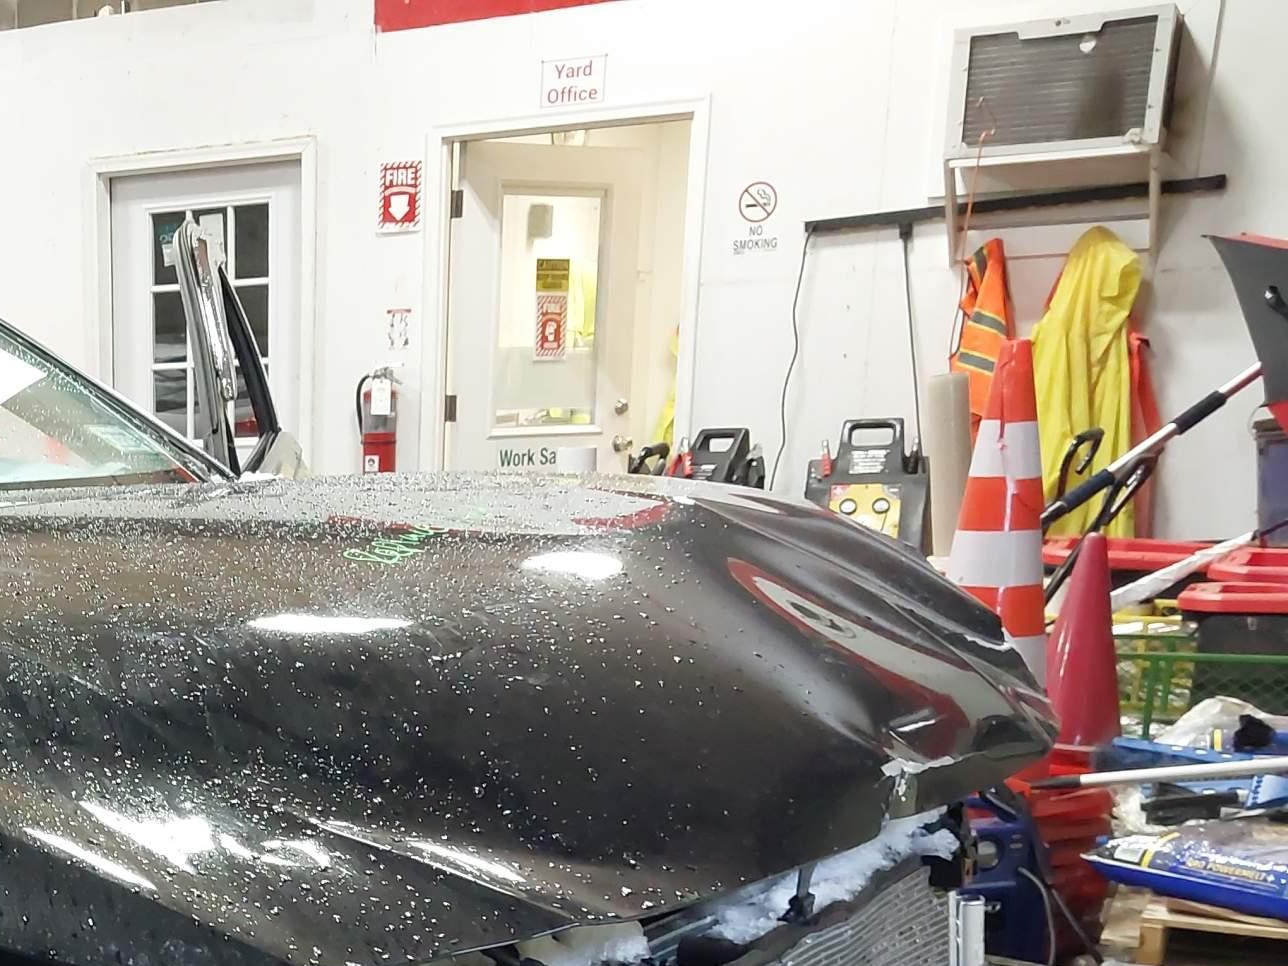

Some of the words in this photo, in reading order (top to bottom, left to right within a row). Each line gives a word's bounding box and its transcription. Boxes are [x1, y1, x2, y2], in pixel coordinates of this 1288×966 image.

[554, 59, 593, 79] Yard
[547, 85, 598, 104] Office
[385, 167, 416, 187] FIRE
[749, 224, 763, 236] NO
[733, 237, 778, 251] SMOKING
[499, 448, 535, 467] Work
